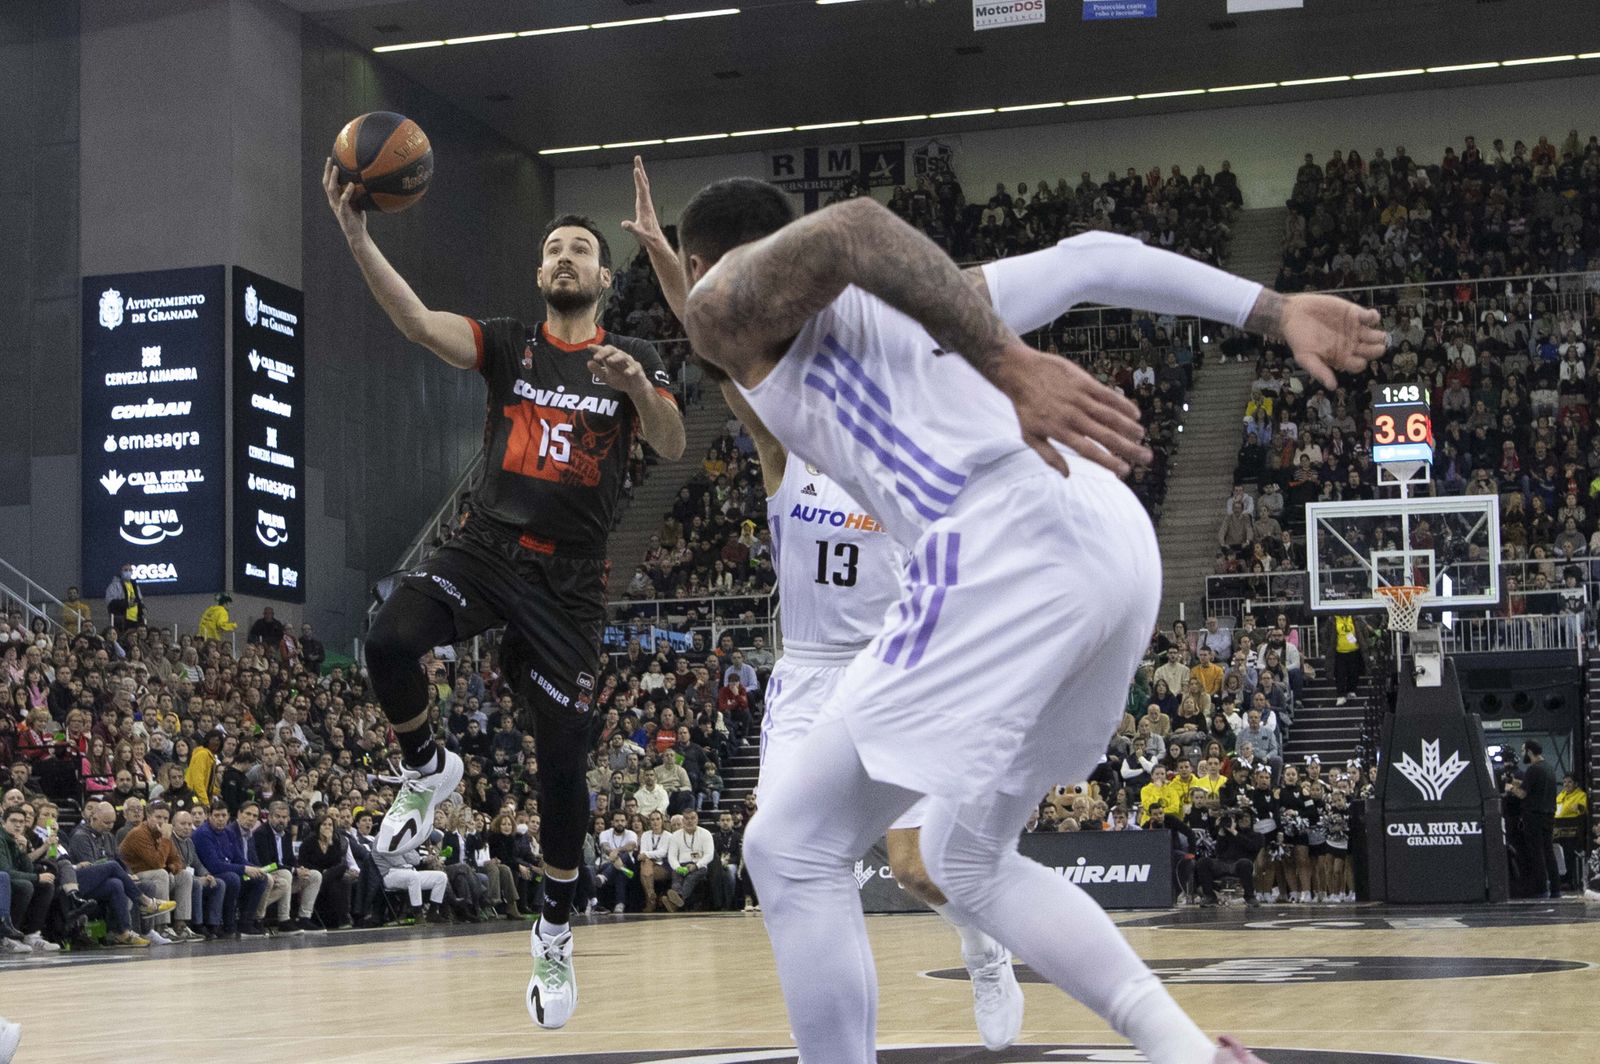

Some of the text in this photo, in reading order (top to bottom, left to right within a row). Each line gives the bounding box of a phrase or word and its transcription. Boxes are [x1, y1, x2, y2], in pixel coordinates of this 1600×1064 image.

[975, 0, 1043, 17] MotorDOS
[126, 294, 205, 310] AYUNTAMIENTO
[131, 308, 198, 324] DE GRANADA
[105, 370, 148, 386] CERVEZAS
[1382, 385, 1419, 402] 1:43
[1375, 412, 1427, 444] 3.6
[118, 431, 200, 450] emasagra
[537, 418, 573, 463] 15
[124, 509, 179, 526] PULEVA
[814, 540, 859, 587] 13
[537, 675, 570, 707] BERNER
[1387, 821, 1483, 837] CAJA RURAL
[1406, 836, 1463, 846] GRANADA
